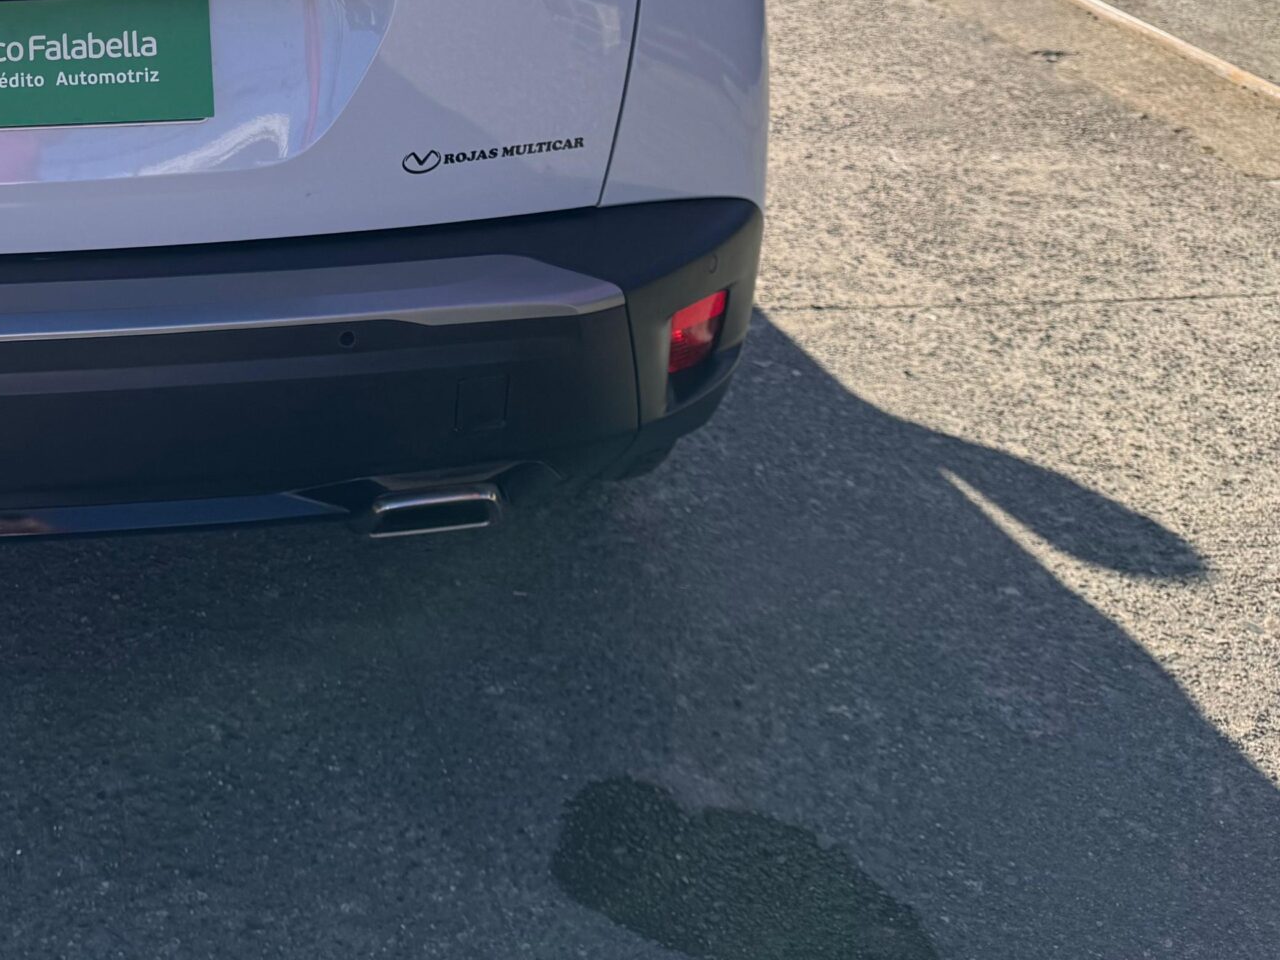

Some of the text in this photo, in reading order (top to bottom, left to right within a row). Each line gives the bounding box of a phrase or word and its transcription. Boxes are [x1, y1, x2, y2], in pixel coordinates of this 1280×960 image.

[55, 67, 160, 87] Automotriz
[443, 137, 585, 165] ROJAS MULTICAR
